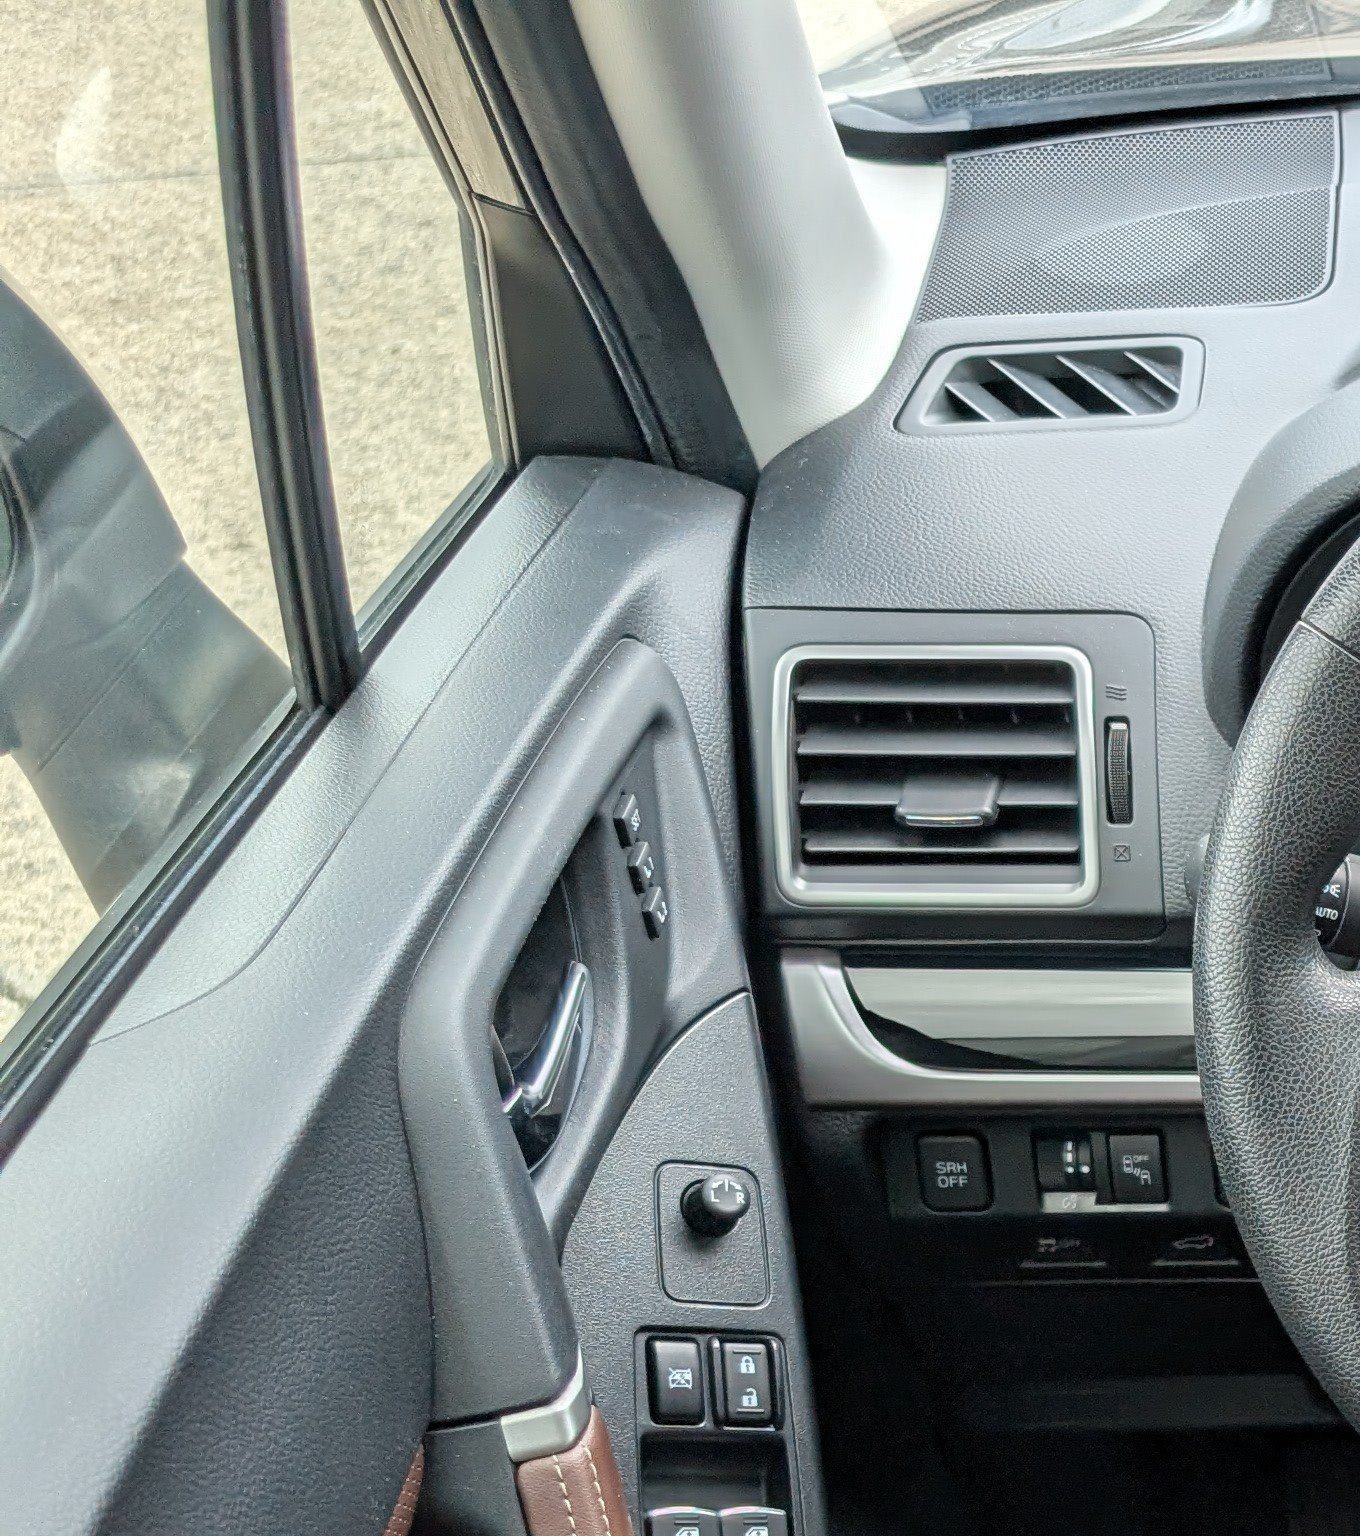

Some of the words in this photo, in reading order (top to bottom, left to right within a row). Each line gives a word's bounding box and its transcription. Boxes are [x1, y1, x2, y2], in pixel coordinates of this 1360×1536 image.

[936, 1162, 967, 1174] SRH
[938, 1175, 968, 1188] OFF
[711, 1189, 720, 1203] L
[736, 1191, 746, 1204] R
